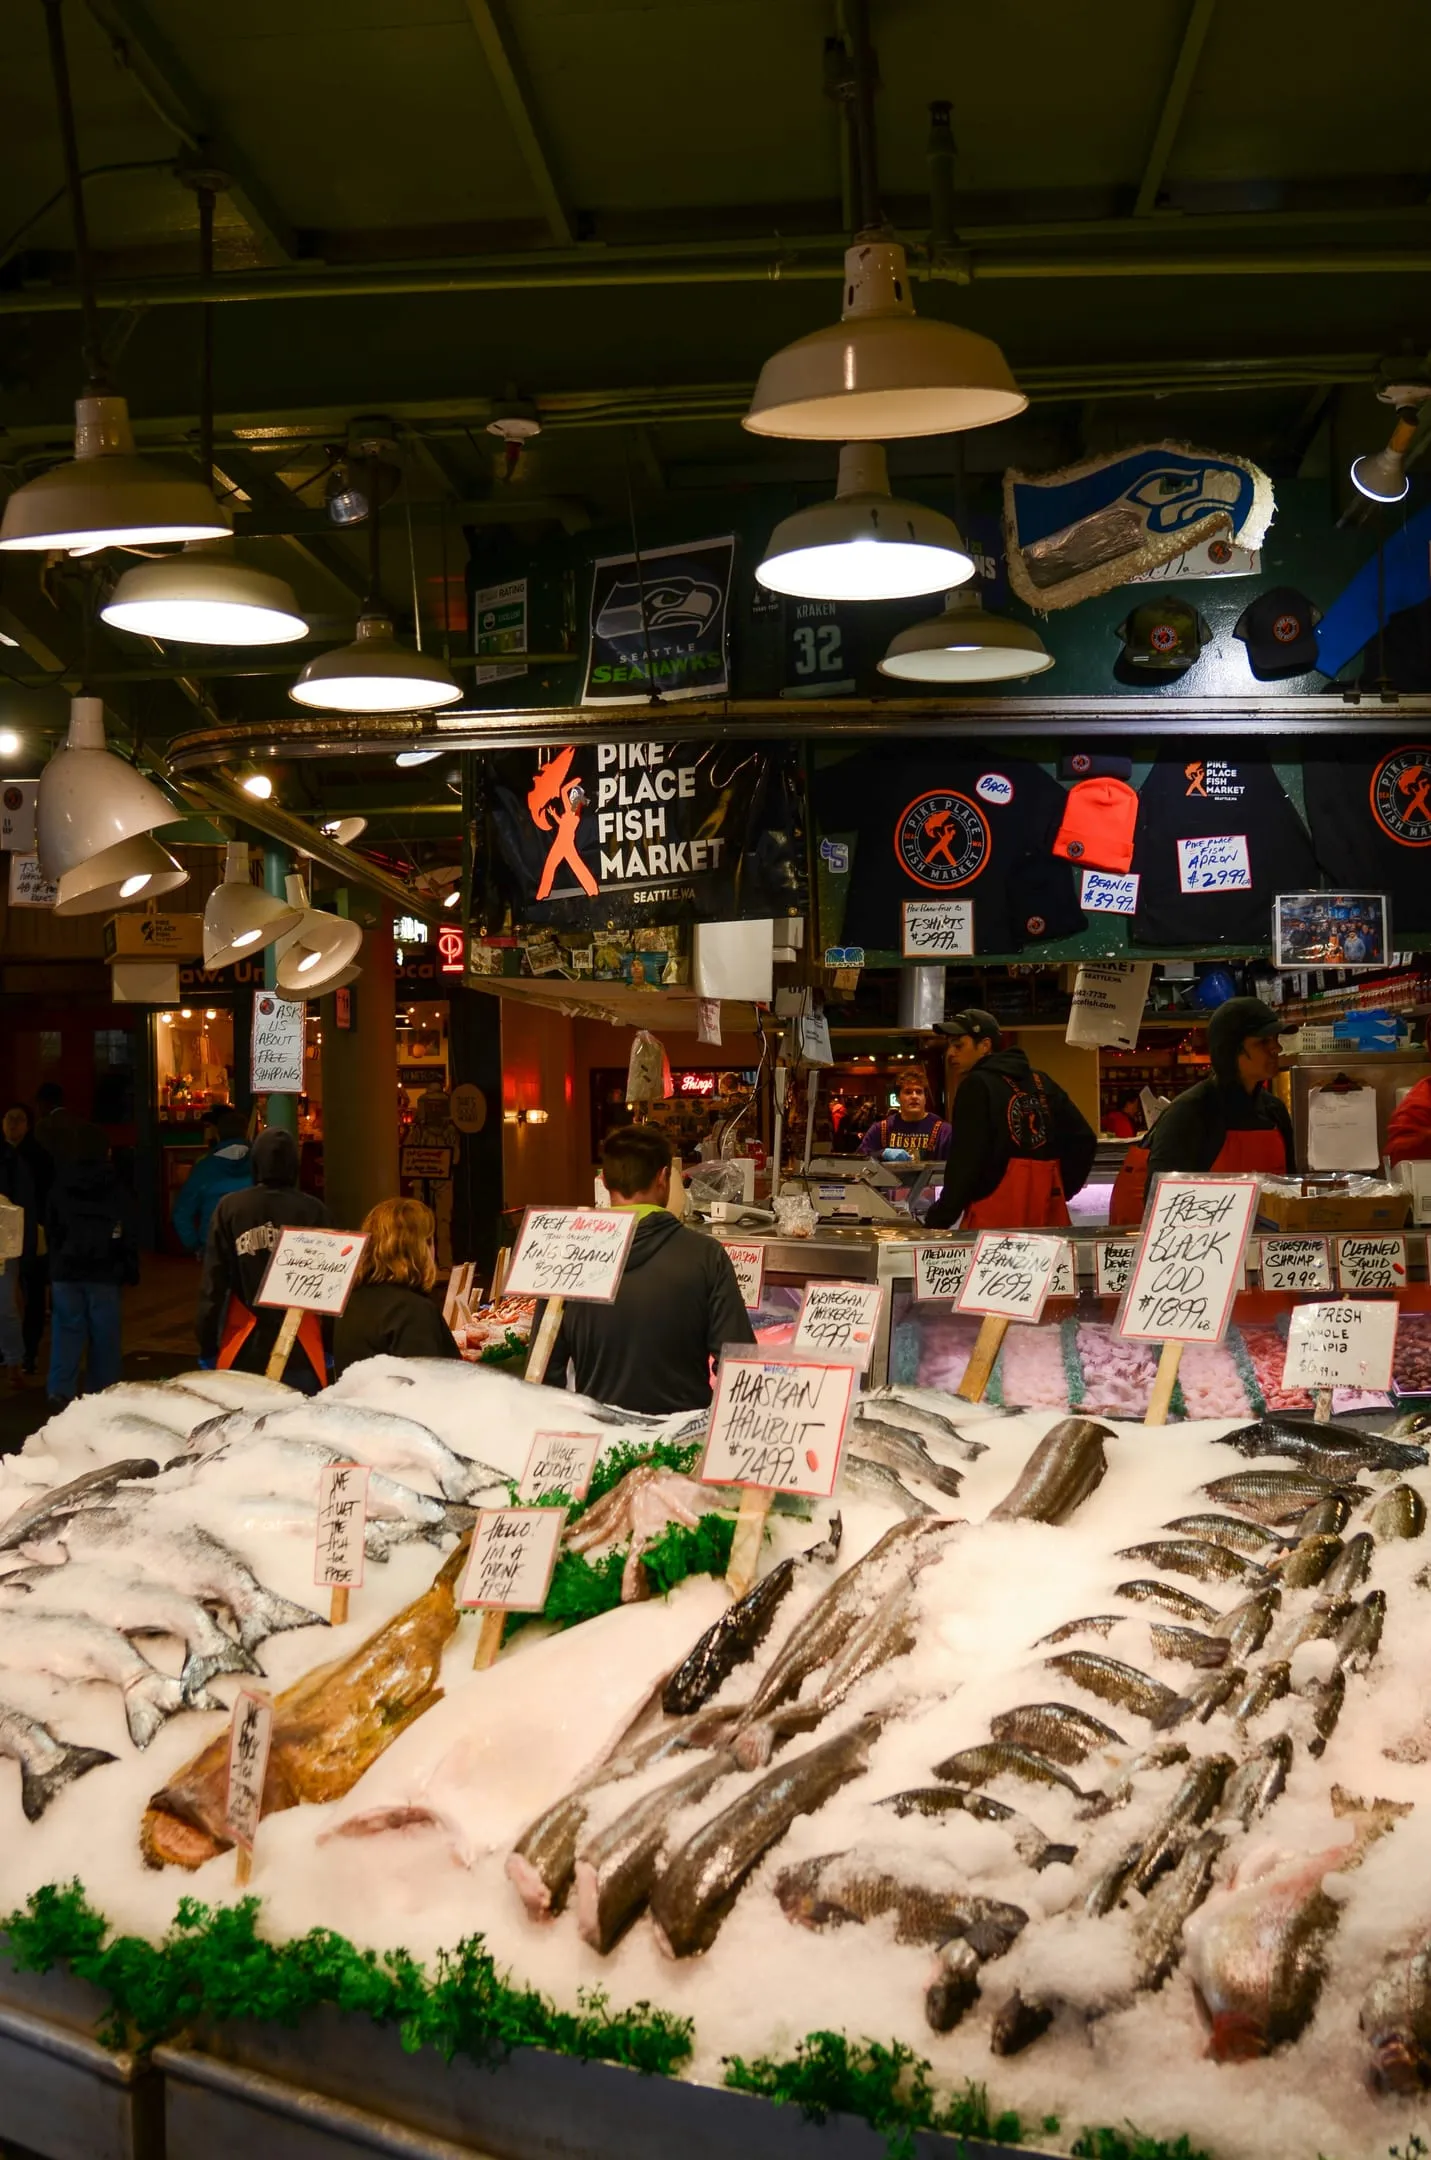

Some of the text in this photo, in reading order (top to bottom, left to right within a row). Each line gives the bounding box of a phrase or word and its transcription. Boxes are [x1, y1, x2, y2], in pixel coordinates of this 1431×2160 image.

[499, 584, 525, 597] RATING
[796, 602, 836, 619] KRAKEN
[619, 643, 696, 664] SEATTLE
[793, 625, 843, 675] 32
[591, 651, 721, 684] SEAHAWKS
[597, 742, 664, 773] PIKE
[1206, 760, 1228, 768] PIKE
[1206, 769, 1237, 777] PLACE
[1381, 759, 1408, 787] PIKE
[598, 766, 696, 808] PLACE
[980, 777, 1011, 794] BACK
[1206, 786, 1246, 794] MARKET
[598, 807, 666, 843] FISH
[908, 800, 982, 835] PIKE PLACE
[1381, 803, 1404, 831] FISH
[1184, 837, 1233, 850] PIKE PLACE
[1200, 846, 1226, 856] FISH
[600, 838, 725, 880] MARKET
[904, 844, 979, 880] FISH MARKET
[1188, 849, 1239, 869] APRON
[1087, 874, 1135, 893] BEANIE
[180, 969, 224, 984] aw.
[276, 1004, 301, 1020] ASK
[269, 1020, 289, 1032] US
[258, 1032, 297, 1046] ABOUT
[257, 1048, 294, 1064] FREE
[254, 1066, 300, 1081] SHIPPING
[889, 1132, 929, 1148] HUSKIE
[1160, 1190, 1237, 1226] FRESH
[530, 1213, 624, 1233] FRESH ALASKAN
[522, 1240, 624, 1264] KING SALMON
[1103, 1242, 1135, 1258] PEELE
[1149, 1225, 1231, 1264] BLACK
[1267, 1239, 1325, 1254] SIDESTRIPE
[1341, 1239, 1400, 1257] CLEANED
[276, 1249, 357, 1275] SILVER SALMON
[921, 1249, 966, 1261] MEDIUM
[1265, 1254, 1315, 1267] SHRIMP
[1340, 1256, 1390, 1269] SQUID
[1151, 1263, 1205, 1295] COD
[1272, 1270, 1316, 1288] 29.99
[806, 1289, 872, 1308] NORWEGIAN
[1138, 1294, 1208, 1330] $18.99
[1317, 1306, 1362, 1323] FRESH
[1307, 1328, 1349, 1340] WHOLE
[763, 1363, 800, 1377] WHOLE
[729, 1366, 829, 1409] ALASKAN
[721, 1404, 826, 1445] HALIBUT
[546, 1440, 584, 1461] WHOLE
[533, 1460, 586, 1482] OCTOPUS
[322, 1518, 347, 1535] THE
[482, 1513, 544, 1543] HELLO!
[510, 1543, 528, 1561] A
[480, 1560, 525, 1579] MONK
[477, 1580, 517, 1604] FISH
